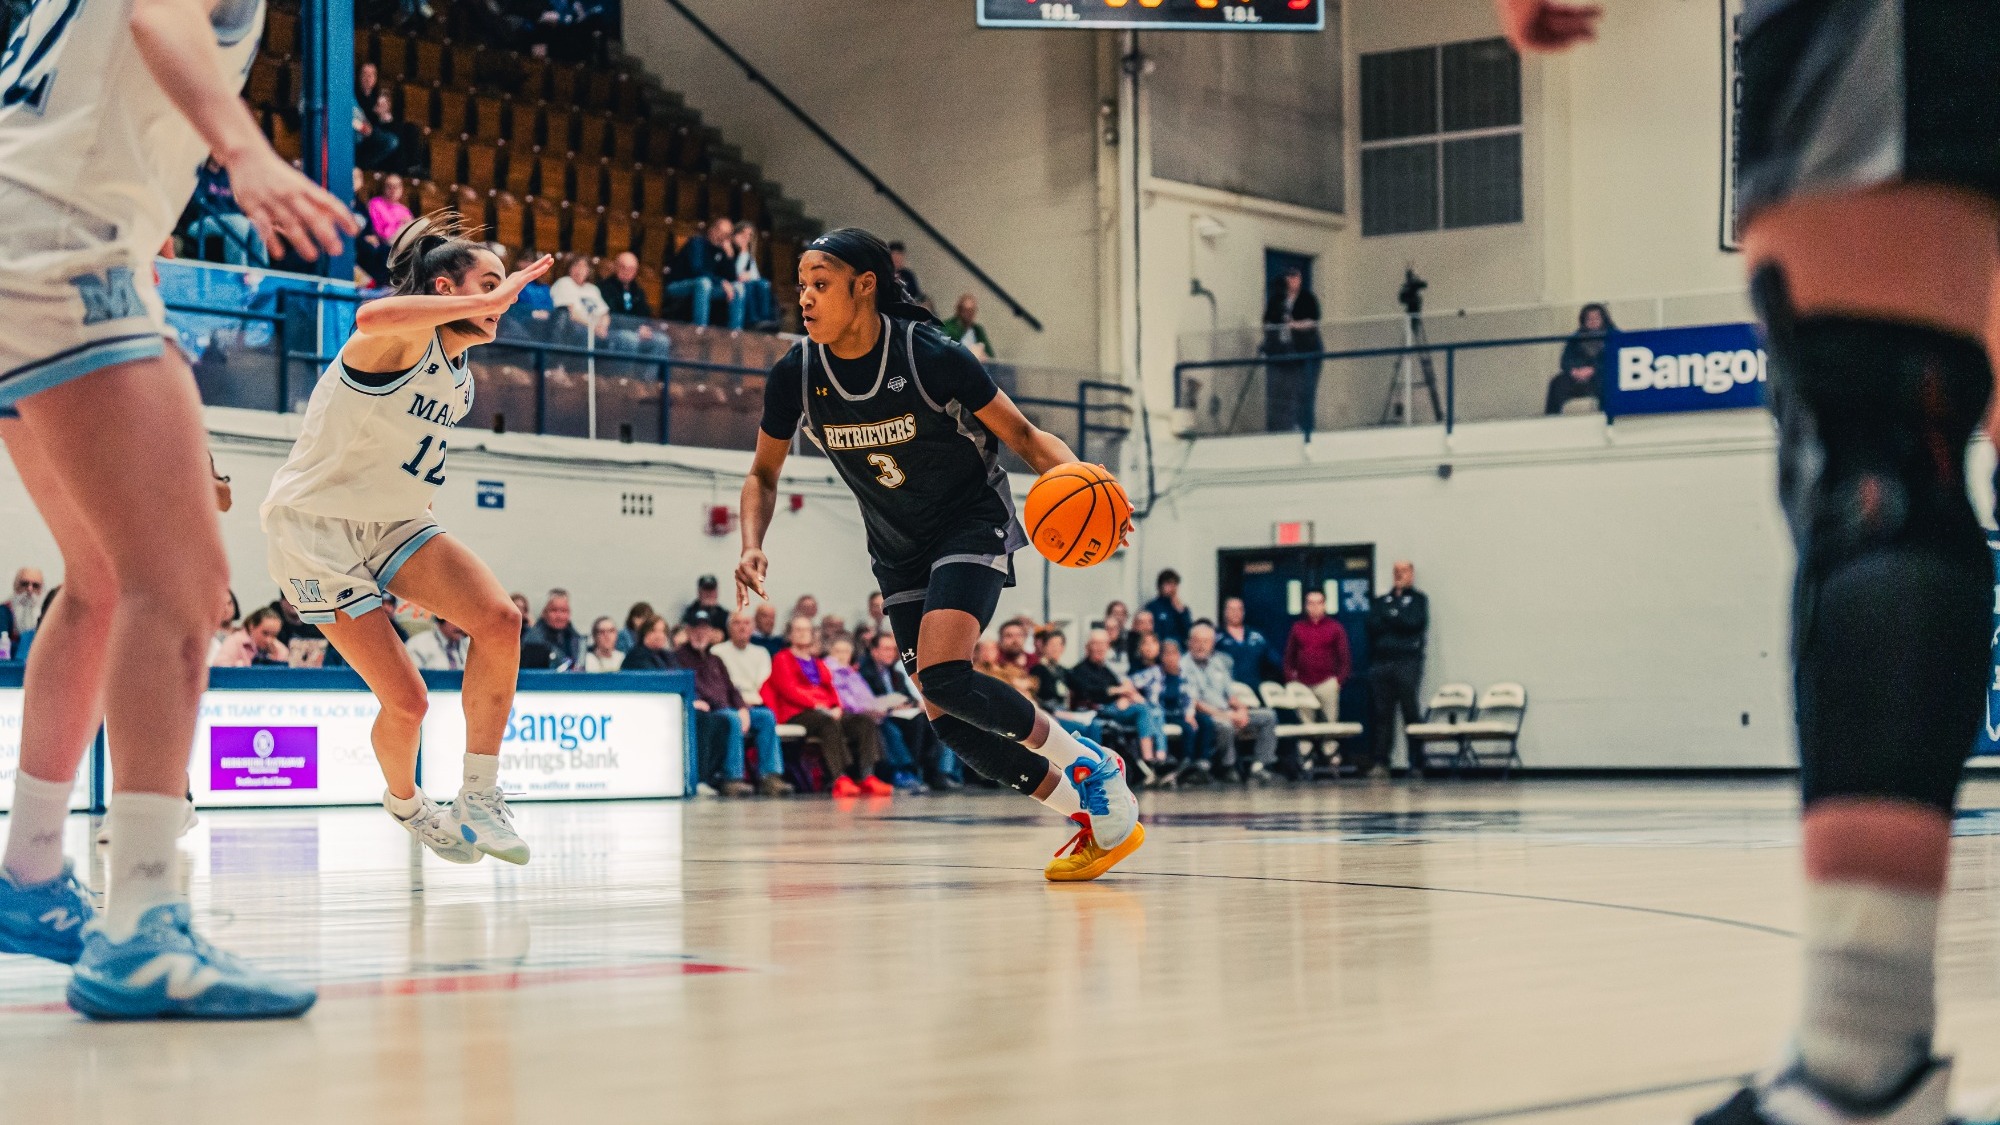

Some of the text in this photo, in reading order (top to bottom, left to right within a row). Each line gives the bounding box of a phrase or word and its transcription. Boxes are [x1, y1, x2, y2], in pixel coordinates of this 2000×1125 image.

[823, 414, 917, 450] RETRIEVERS
[401, 434, 447, 486] 12
[867, 453, 906, 489] 3
[501, 747, 619, 775] avings Bank
